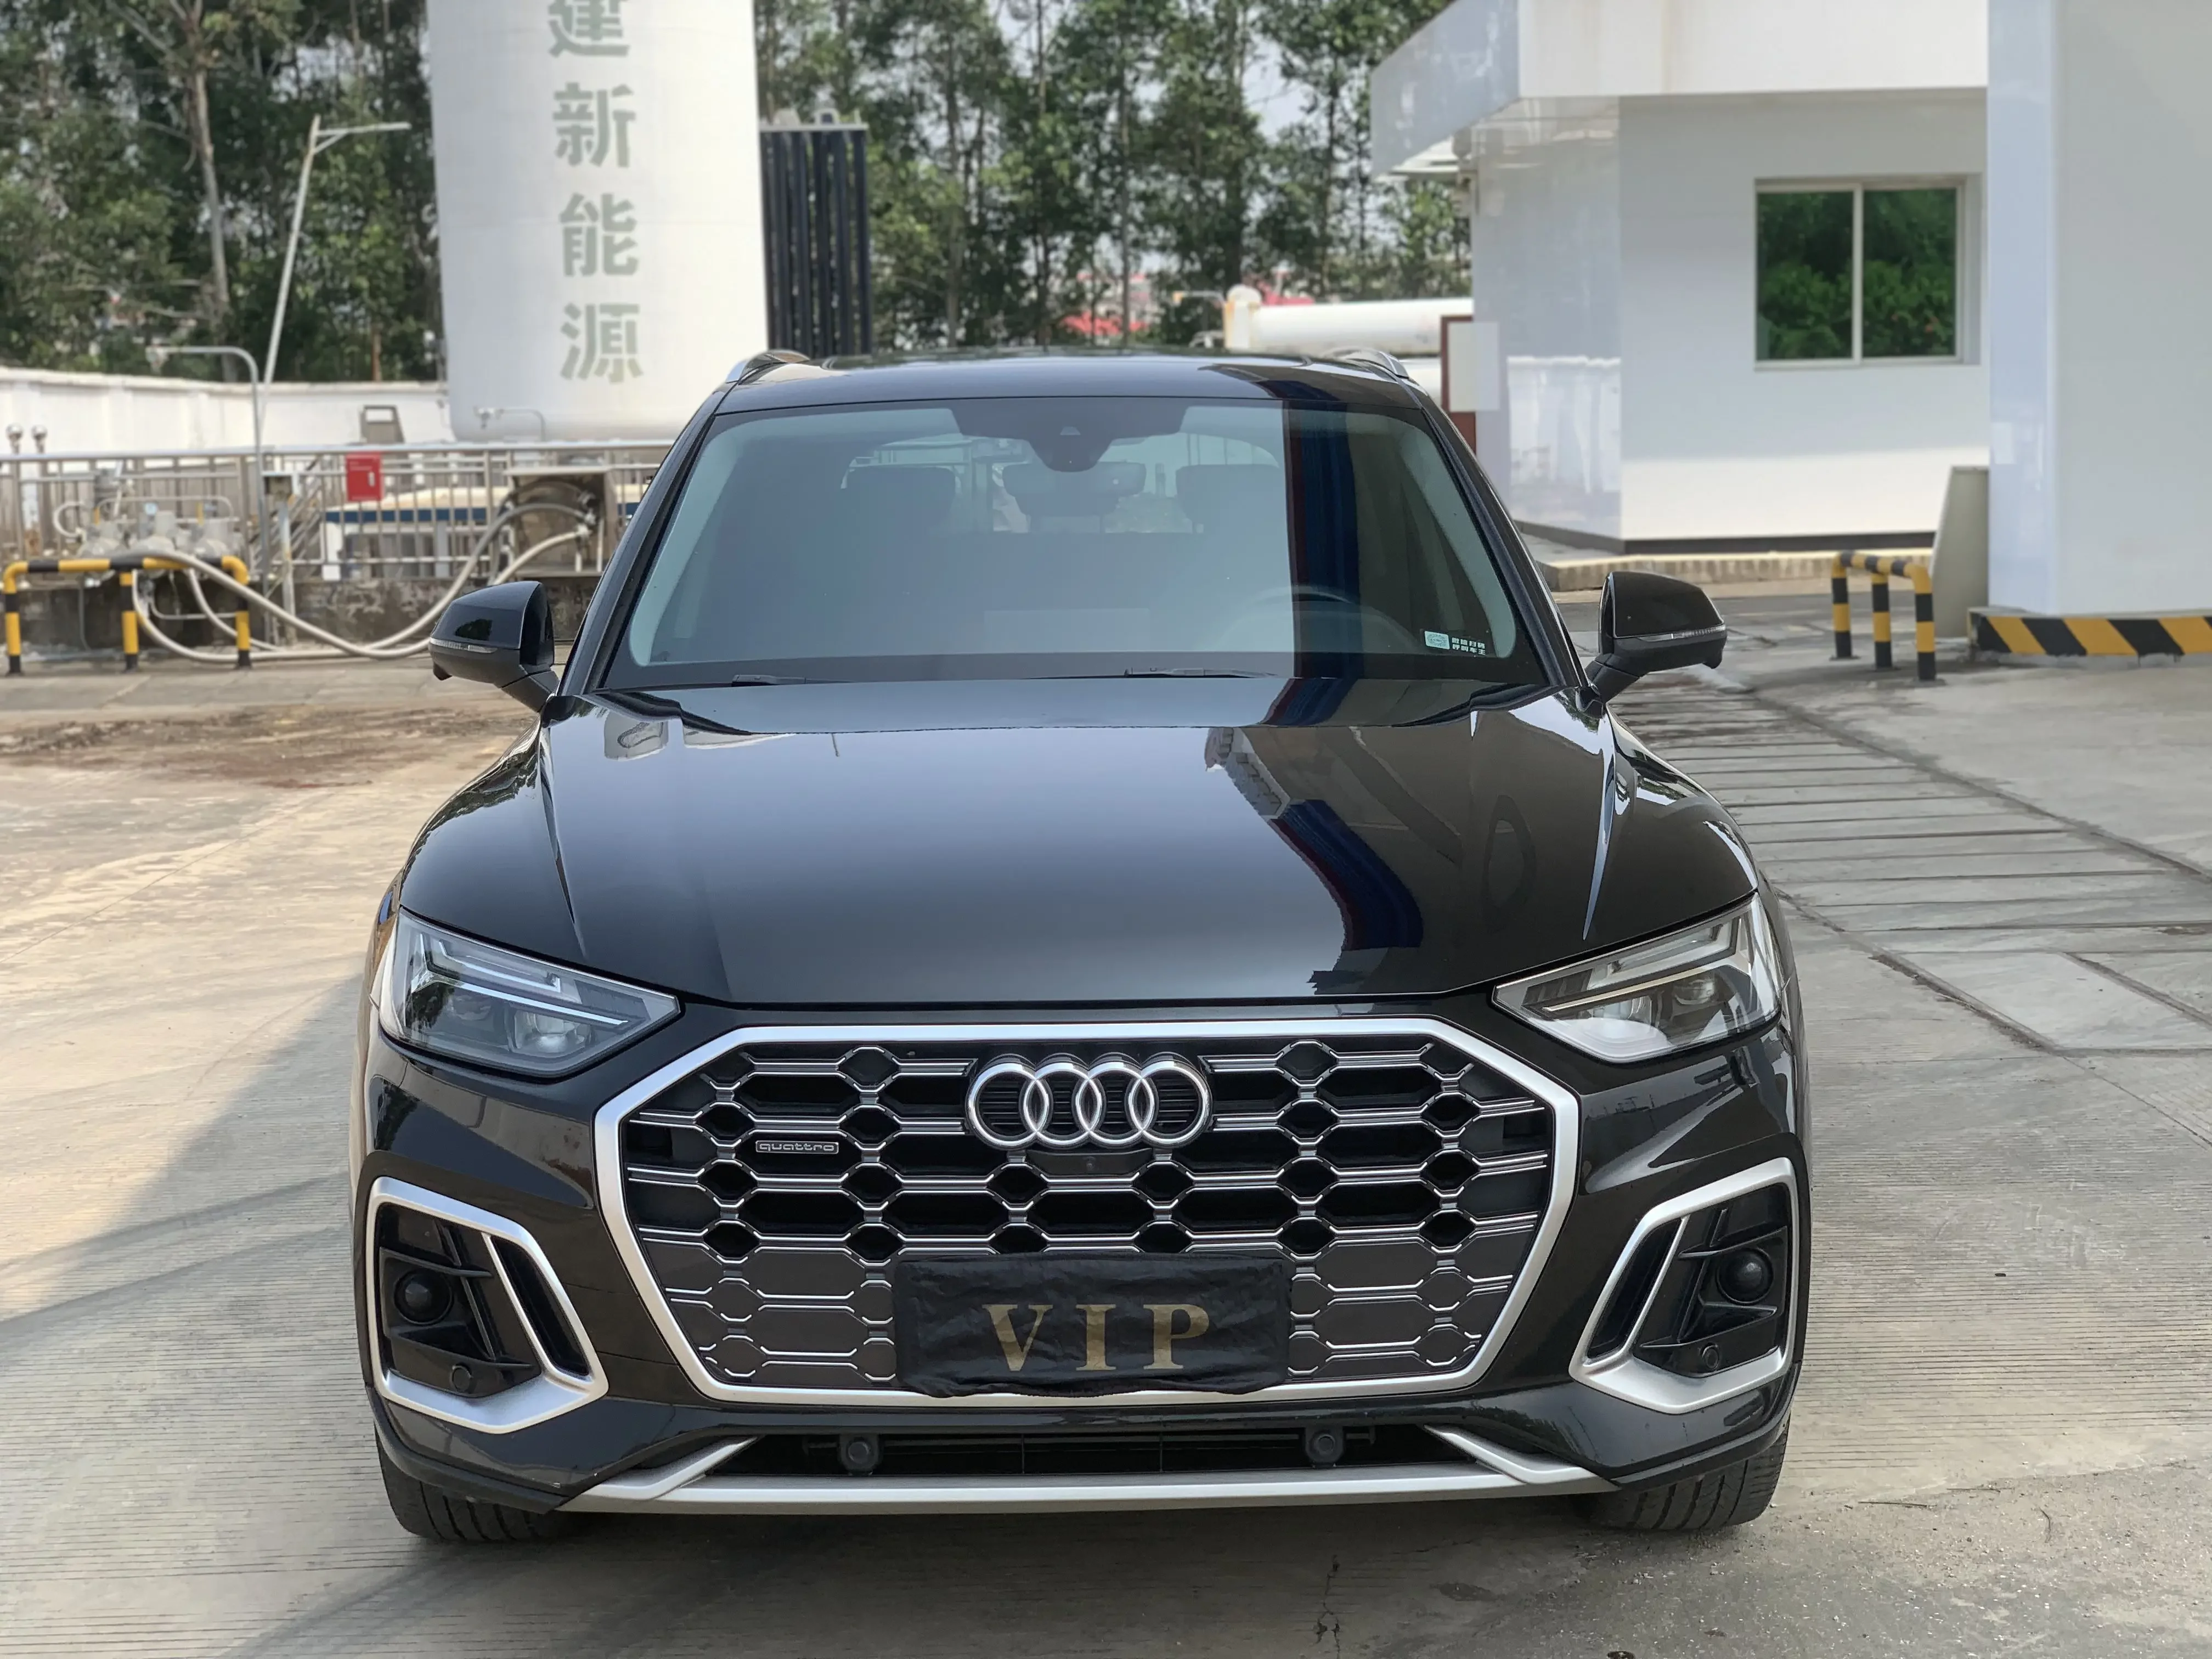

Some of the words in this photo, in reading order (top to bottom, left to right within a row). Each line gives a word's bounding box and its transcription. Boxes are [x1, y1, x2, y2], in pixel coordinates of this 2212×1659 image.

[548, 0, 643, 383] 建新能源
[759, 1143, 834, 1152] quattro
[982, 1304, 1210, 1372] VIP
